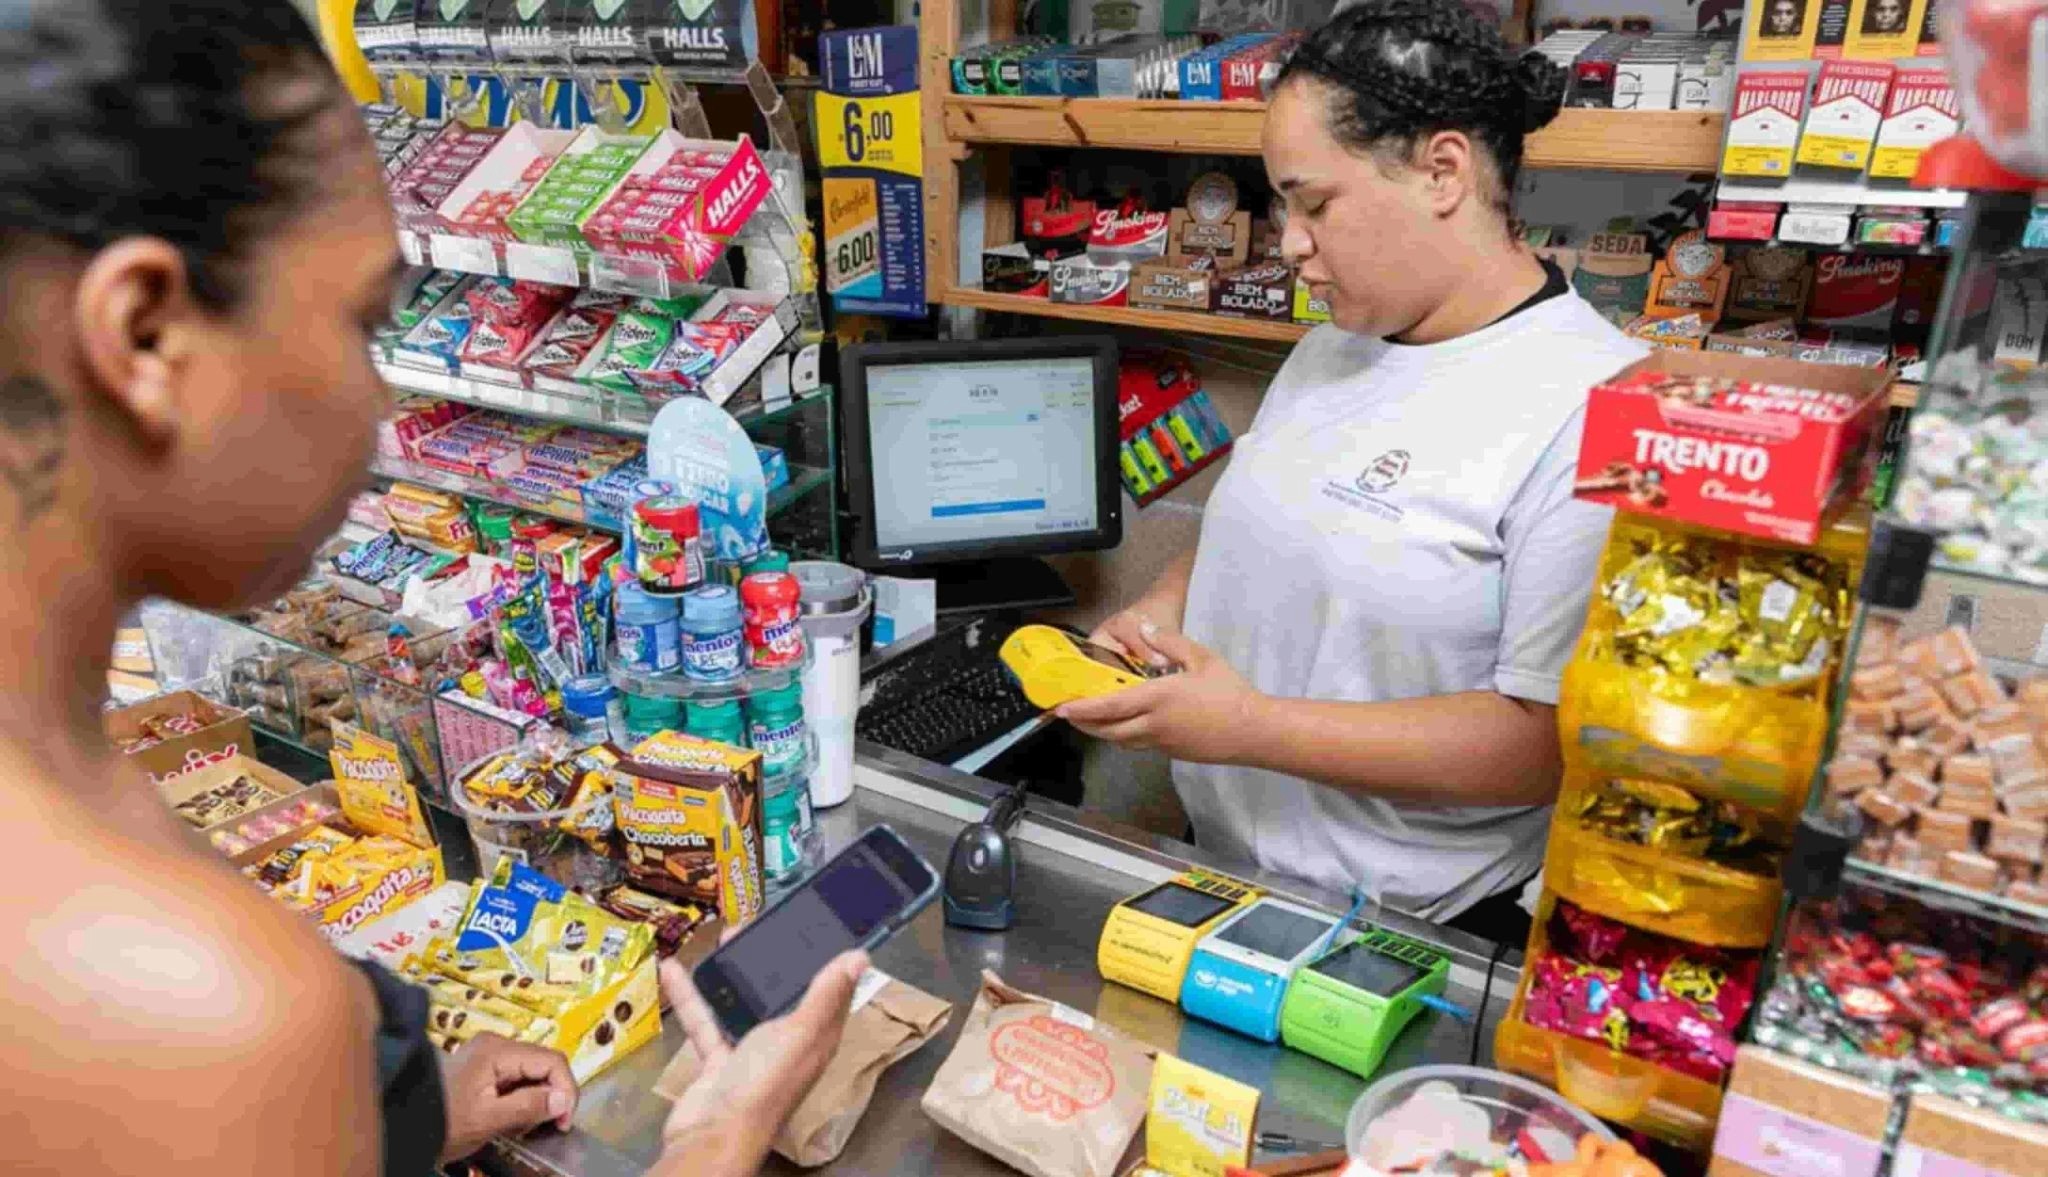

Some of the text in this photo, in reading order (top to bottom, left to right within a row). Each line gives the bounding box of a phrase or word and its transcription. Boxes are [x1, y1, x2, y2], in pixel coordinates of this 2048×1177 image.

[579, 27, 635, 47] HALLS
[664, 27, 729, 51] HALLS
[847, 32, 884, 79] L&M
[1737, 90, 1802, 117] MARLBORO
[1817, 76, 1888, 109] MARLBORO
[843, 101, 893, 162] 6,00
[707, 155, 762, 228] HALLS
[1095, 208, 1164, 237] Smoking
[1053, 266, 1118, 294] Smoking
[1154, 273, 1181, 286] BEM
[1817, 256, 1905, 284] Smoking
[1143, 285, 1195, 300] BOLADO
[1220, 294, 1278, 310] BOLADO
[1234, 283, 1263, 297] BEM
[473, 331, 509, 348] Trident
[614, 321, 656, 341] Trident
[1632, 428, 1770, 483] TRENTO
[469, 908, 518, 937] LACTA
